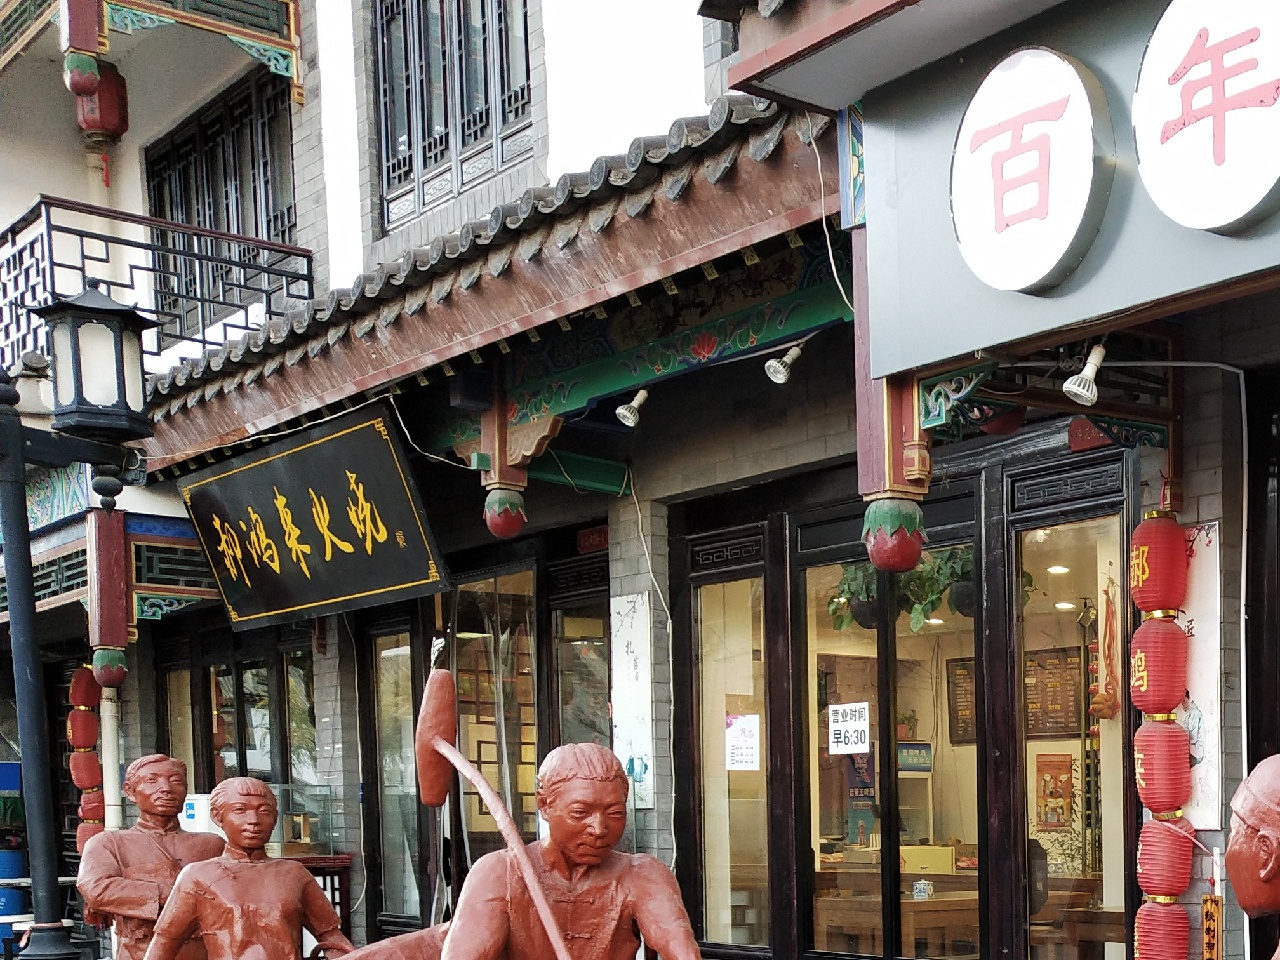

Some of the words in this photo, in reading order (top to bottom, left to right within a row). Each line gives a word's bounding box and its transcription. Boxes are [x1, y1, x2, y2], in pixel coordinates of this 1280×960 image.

[831, 706, 866, 724] 营业时间
[831, 729, 866, 748] 早6:30
